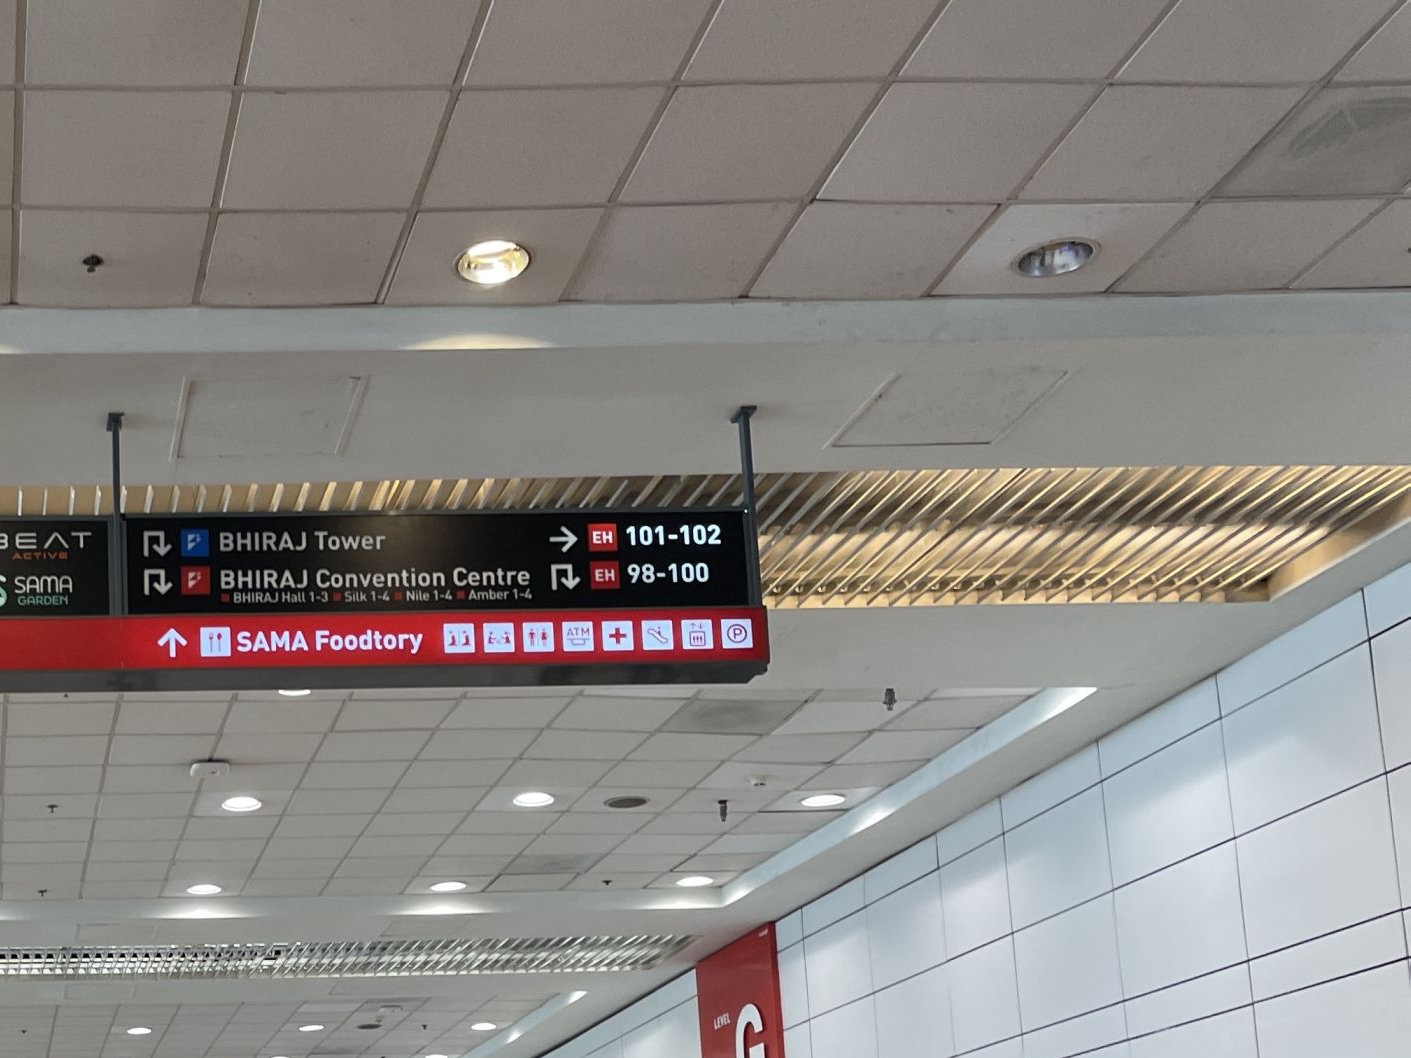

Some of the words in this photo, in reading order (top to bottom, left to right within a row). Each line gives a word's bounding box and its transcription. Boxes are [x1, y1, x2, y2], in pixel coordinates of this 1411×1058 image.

[219, 532, 307, 552] BHIRAJ
[315, 531, 385, 550] Tower
[592, 531, 613, 544] EH
[626, 524, 721, 546] 101-102
[13, 552, 67, 560] ACTIVE
[220, 570, 308, 590] BHIRAJ
[316, 568, 445, 588] Convention
[453, 568, 530, 586] Centre
[595, 570, 615, 582] EH
[627, 562, 709, 584] 98-100
[15, 576, 73, 593] SAMA
[18, 596, 69, 606] GARDEN
[233, 592, 279, 603] BHIRAJ
[281, 592, 305, 602] Hall
[309, 592, 329, 602] 1-3
[345, 590, 367, 602] Silk
[371, 591, 389, 601] 1-4
[406, 590, 430, 601] Nile
[433, 590, 453, 600] 1-4
[469, 589, 509, 600] Amber
[513, 590, 533, 600] 1-4
[567, 628, 589, 636] ATM
[237, 630, 309, 652] SAMA
[315, 630, 423, 654] Foodtory
[713, 1012, 731, 1030] LEVEL
